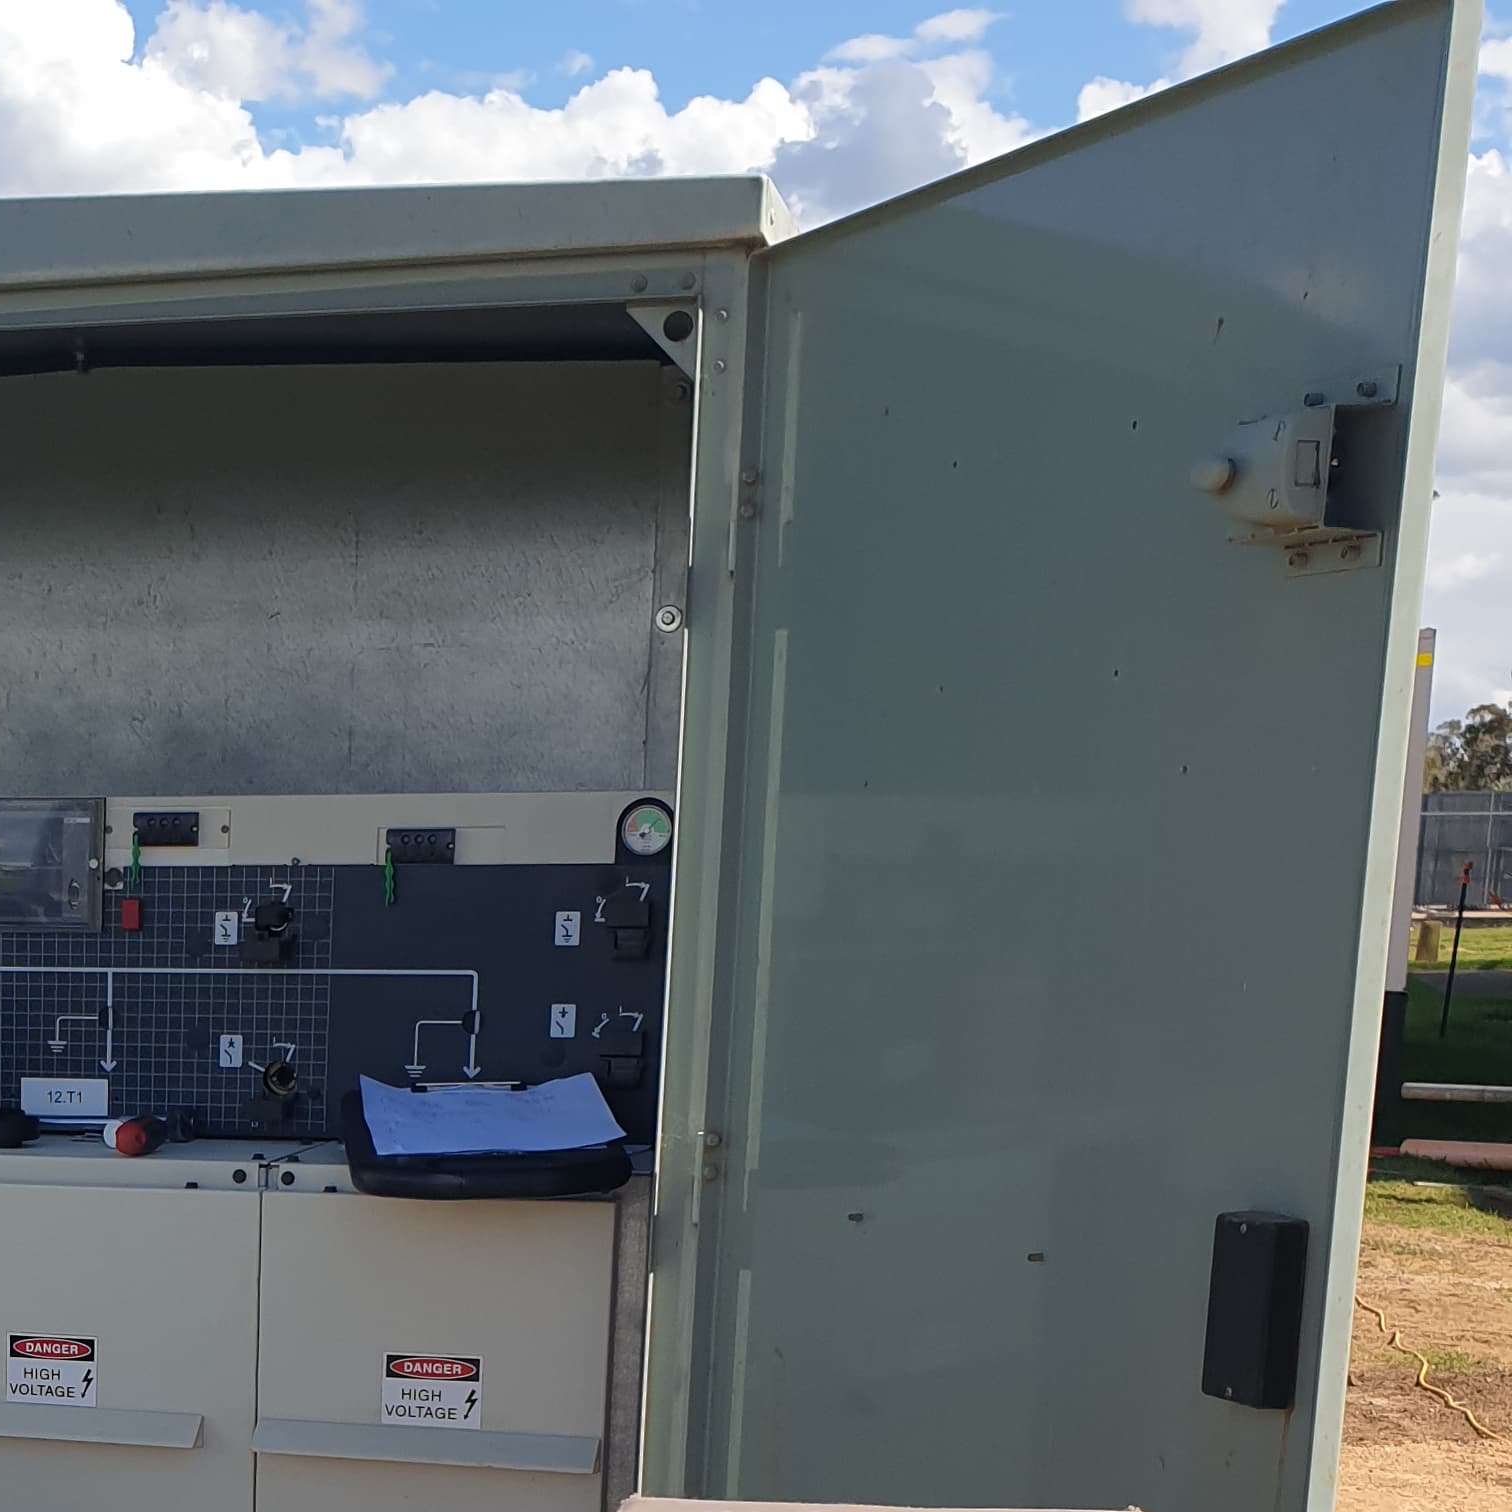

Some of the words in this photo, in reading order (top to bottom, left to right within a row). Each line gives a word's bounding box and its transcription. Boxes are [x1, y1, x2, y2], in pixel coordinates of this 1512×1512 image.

[48, 1090, 83, 1104] 12.T1
[26, 1342, 78, 1355] DANGER
[23, 1367, 61, 1380] HIGH
[404, 1361, 462, 1375] DANGER
[9, 1383, 76, 1398] VOLTAGE
[401, 1388, 442, 1402] HIGH
[385, 1404, 457, 1420] VOLTAGE
